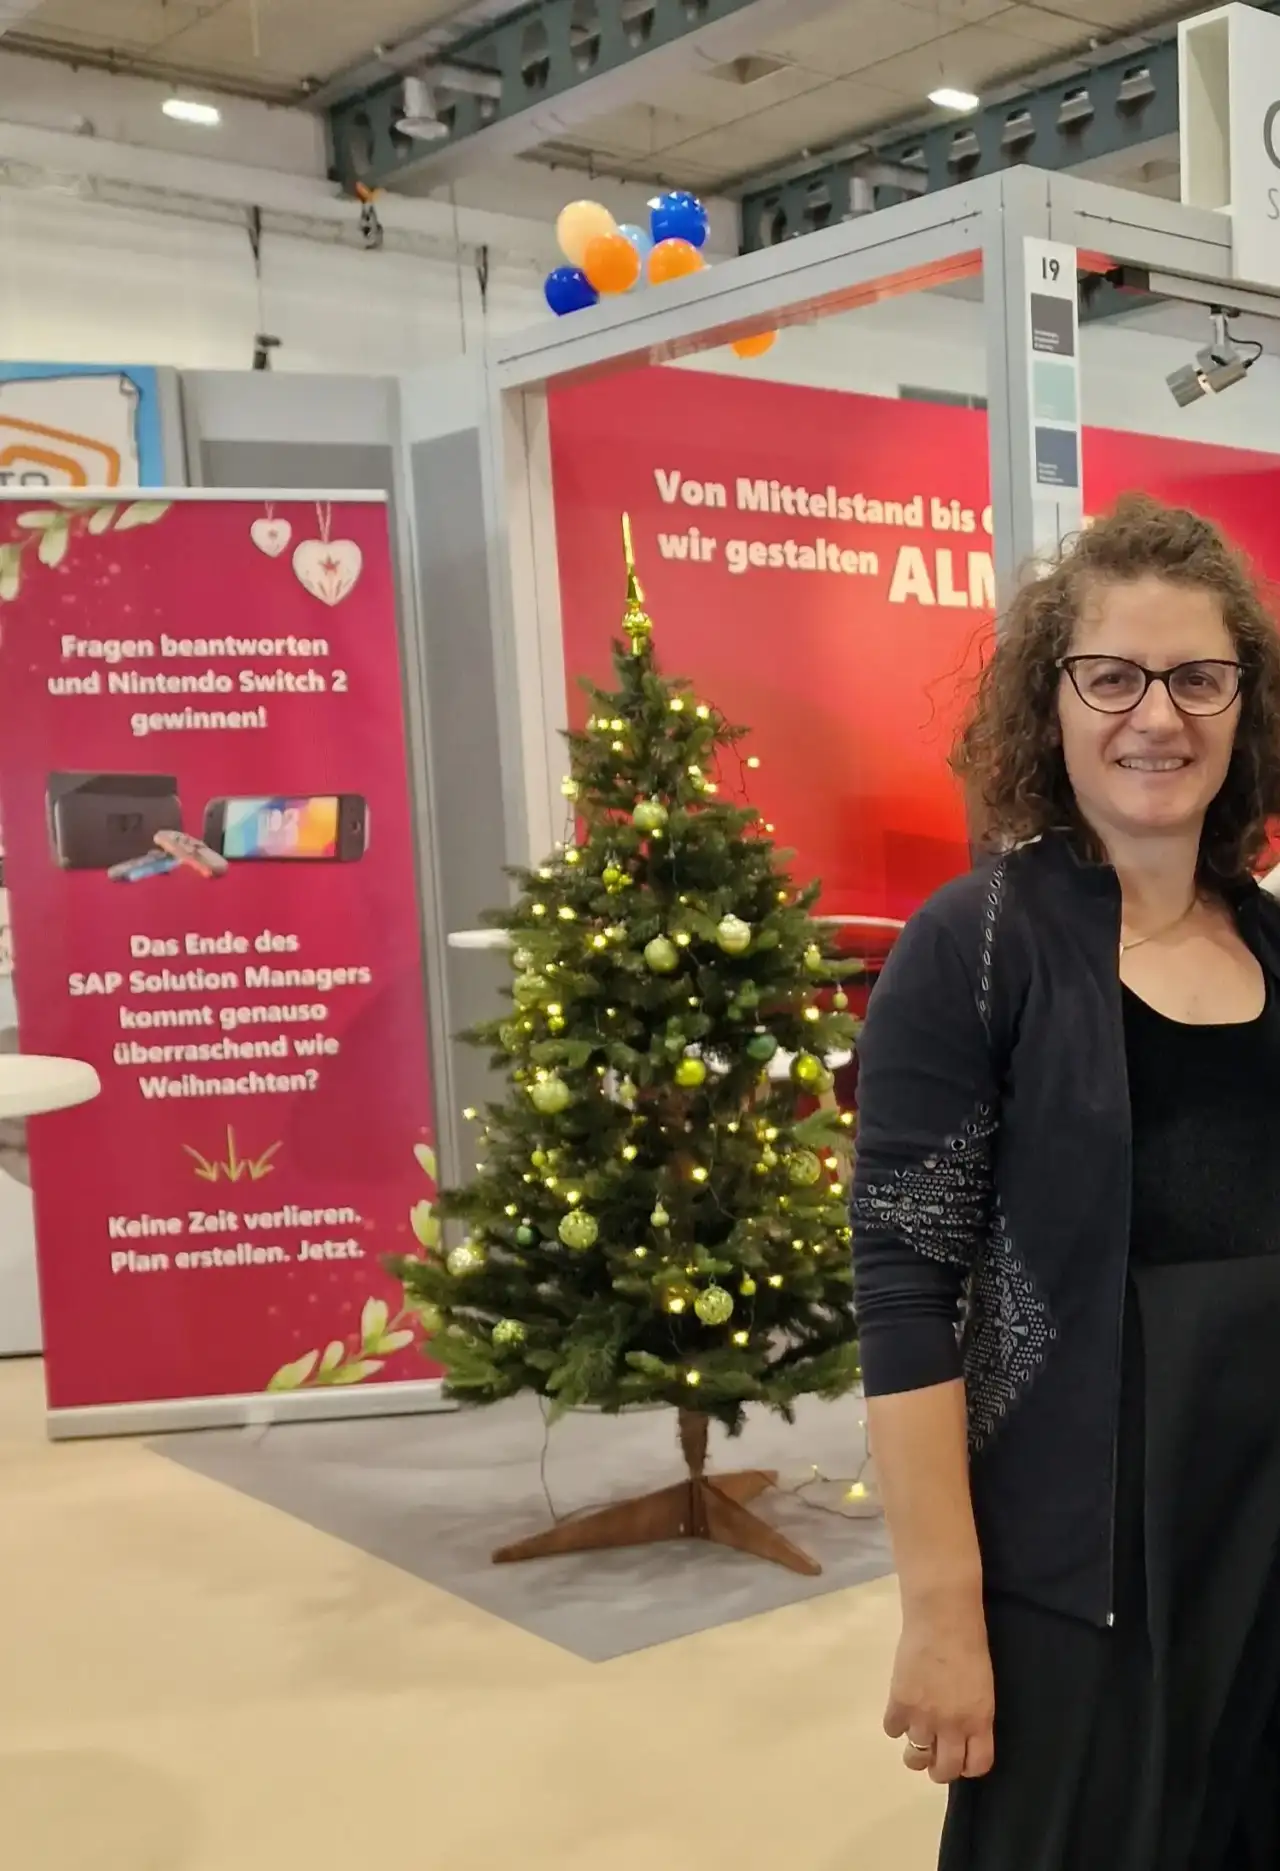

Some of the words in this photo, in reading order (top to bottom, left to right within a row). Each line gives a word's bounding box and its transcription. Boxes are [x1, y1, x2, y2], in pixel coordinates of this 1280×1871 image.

[1041, 256, 1060, 281] 19
[655, 470, 726, 507] Von
[737, 479, 923, 527] Mittelstand
[931, 498, 975, 532] bis
[659, 528, 716, 561] wir
[726, 539, 878, 575] gestalten
[62, 636, 154, 663] Fragen
[161, 634, 328, 656] beantworten
[48, 671, 100, 694] und
[109, 670, 232, 693] Nintendo
[239, 669, 325, 692] Switch
[332, 670, 347, 691] 2
[131, 706, 266, 736] gewinnen!
[131, 936, 178, 957] Das
[185, 931, 248, 954] Ende
[255, 930, 298, 952] des
[69, 972, 122, 995] SAP
[130, 969, 237, 993] Solution
[245, 966, 371, 990] Managers
[120, 1006, 213, 1028] kommt
[220, 1004, 327, 1030] genauso
[114, 1035, 287, 1064] überraschend
[294, 1034, 339, 1055] wie
[140, 1069, 318, 1098] Weihnachten?
[109, 1215, 182, 1237] Keine
[189, 1210, 238, 1232] Zeit
[244, 1206, 361, 1229] verlieren.
[112, 1251, 168, 1273] Plan
[175, 1244, 290, 1268] erstellen.
[297, 1239, 364, 1260] Jetzt.
